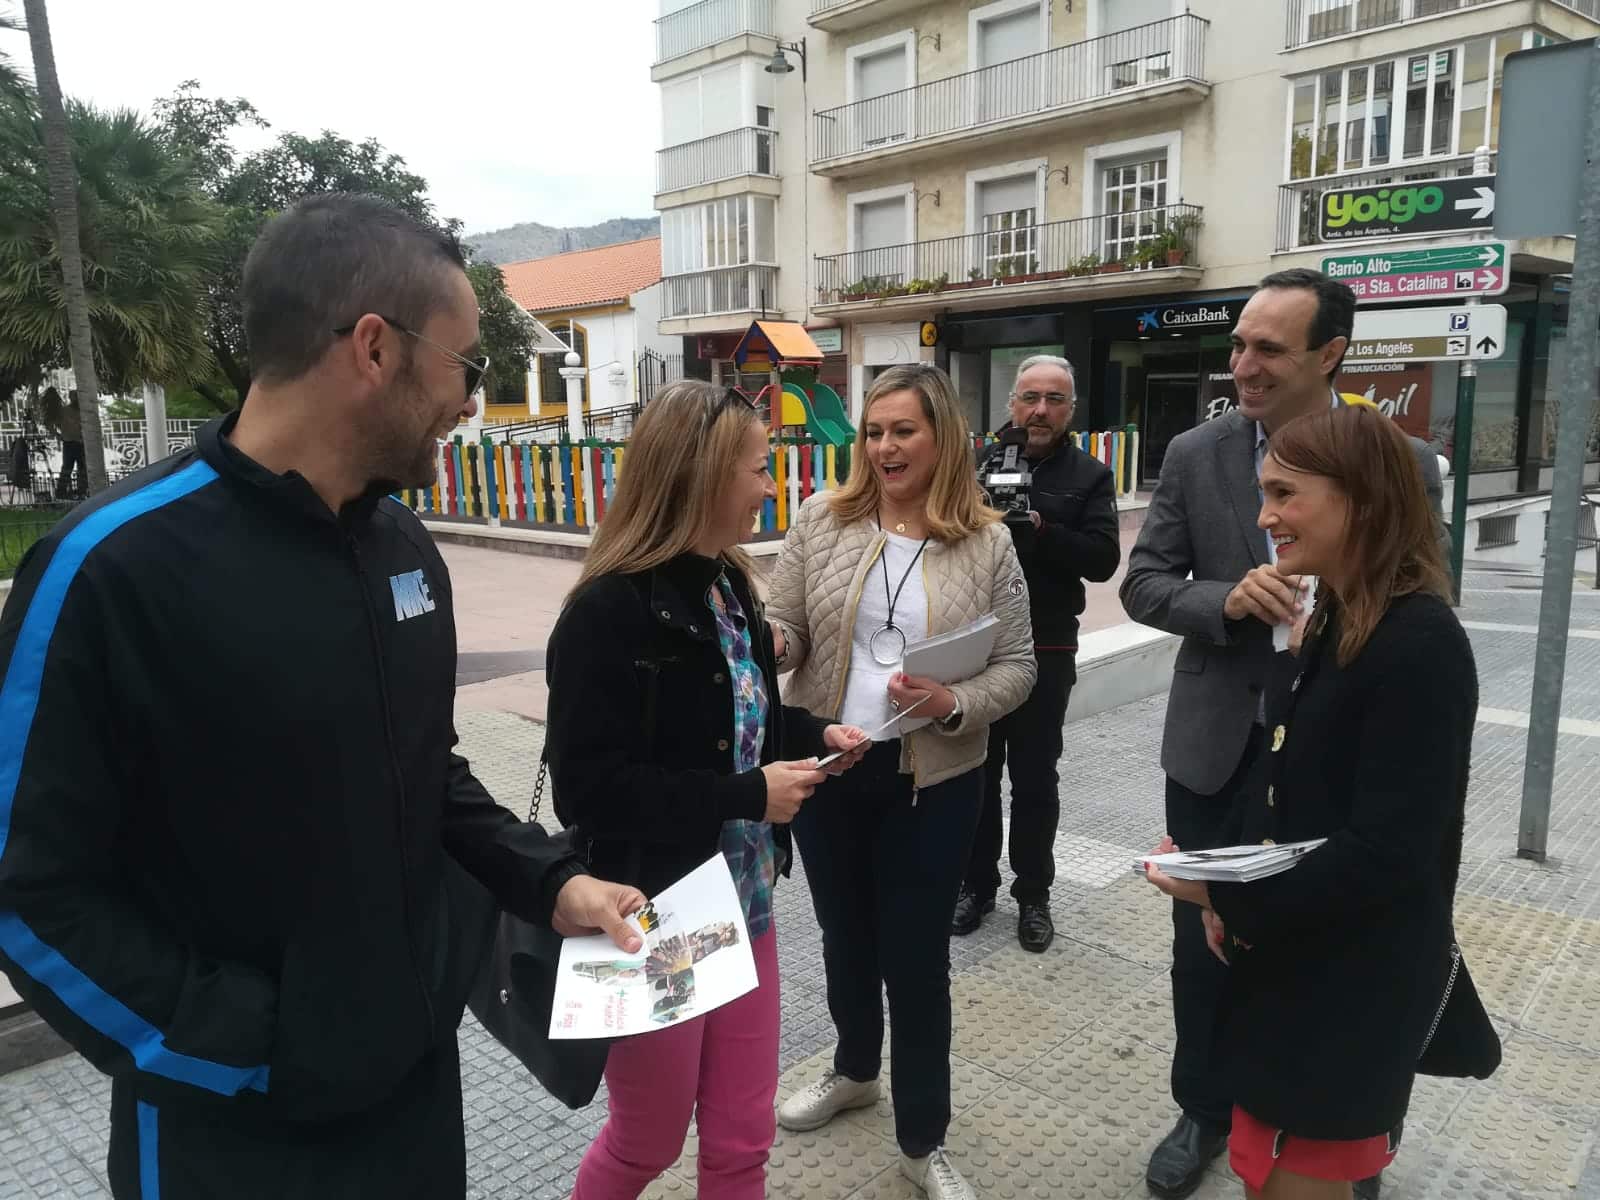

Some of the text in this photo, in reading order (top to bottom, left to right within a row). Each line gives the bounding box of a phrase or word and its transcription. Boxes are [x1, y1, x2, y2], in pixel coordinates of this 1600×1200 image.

[1326, 186, 1444, 228] yoigo
[1328, 258, 1391, 277] Barrio Alto
[1370, 279, 1393, 294] Sta.
[1398, 275, 1448, 292] Catalina
[1162, 305, 1230, 325] CaixaBank
[1356, 343, 1373, 356] Los
[1375, 341, 1414, 357] Angeles
